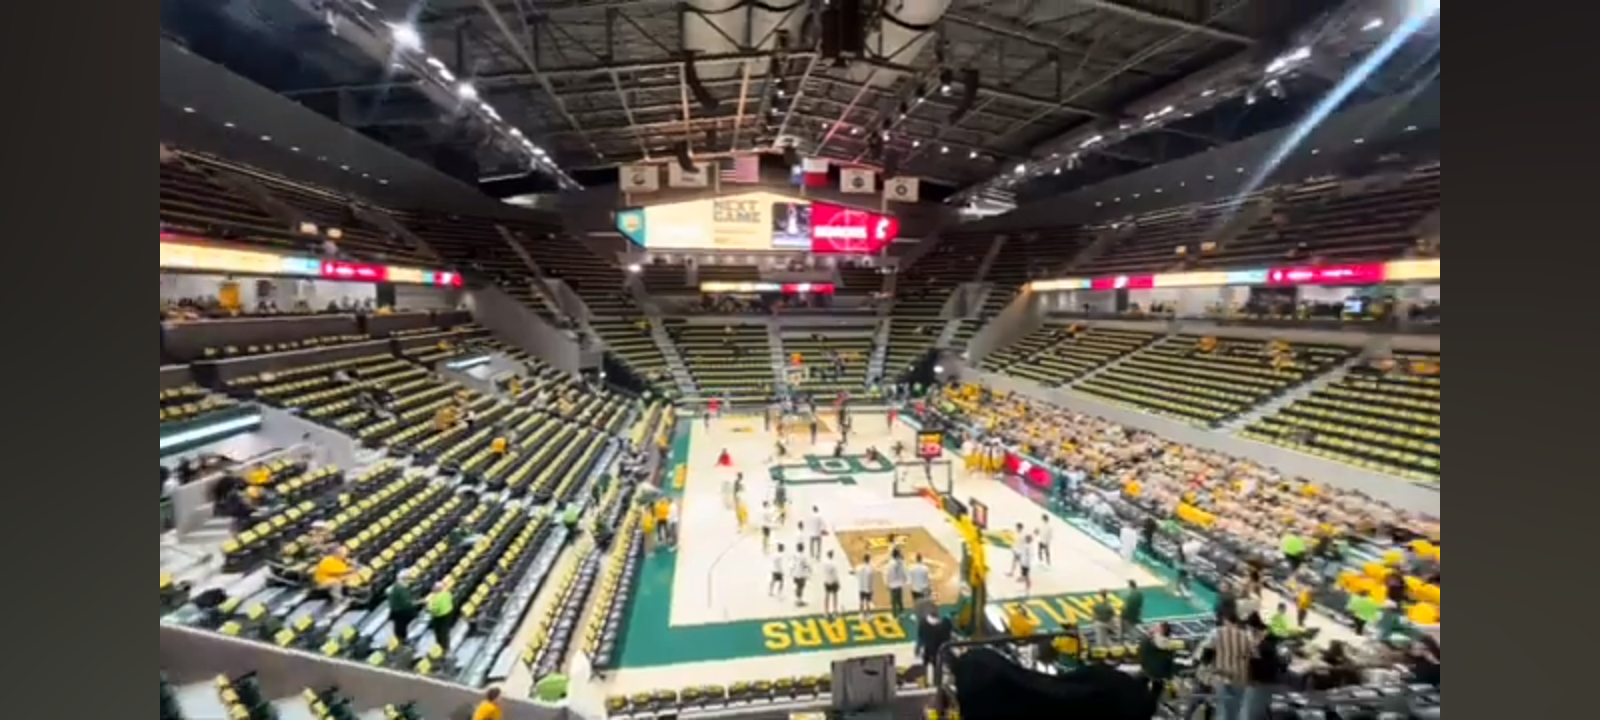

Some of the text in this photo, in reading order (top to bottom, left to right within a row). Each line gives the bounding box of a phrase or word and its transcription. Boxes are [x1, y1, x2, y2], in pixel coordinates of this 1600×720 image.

[713, 199, 759, 211] NEXT
[713, 211, 761, 223] GAME
[762, 612, 906, 650] BEARS
